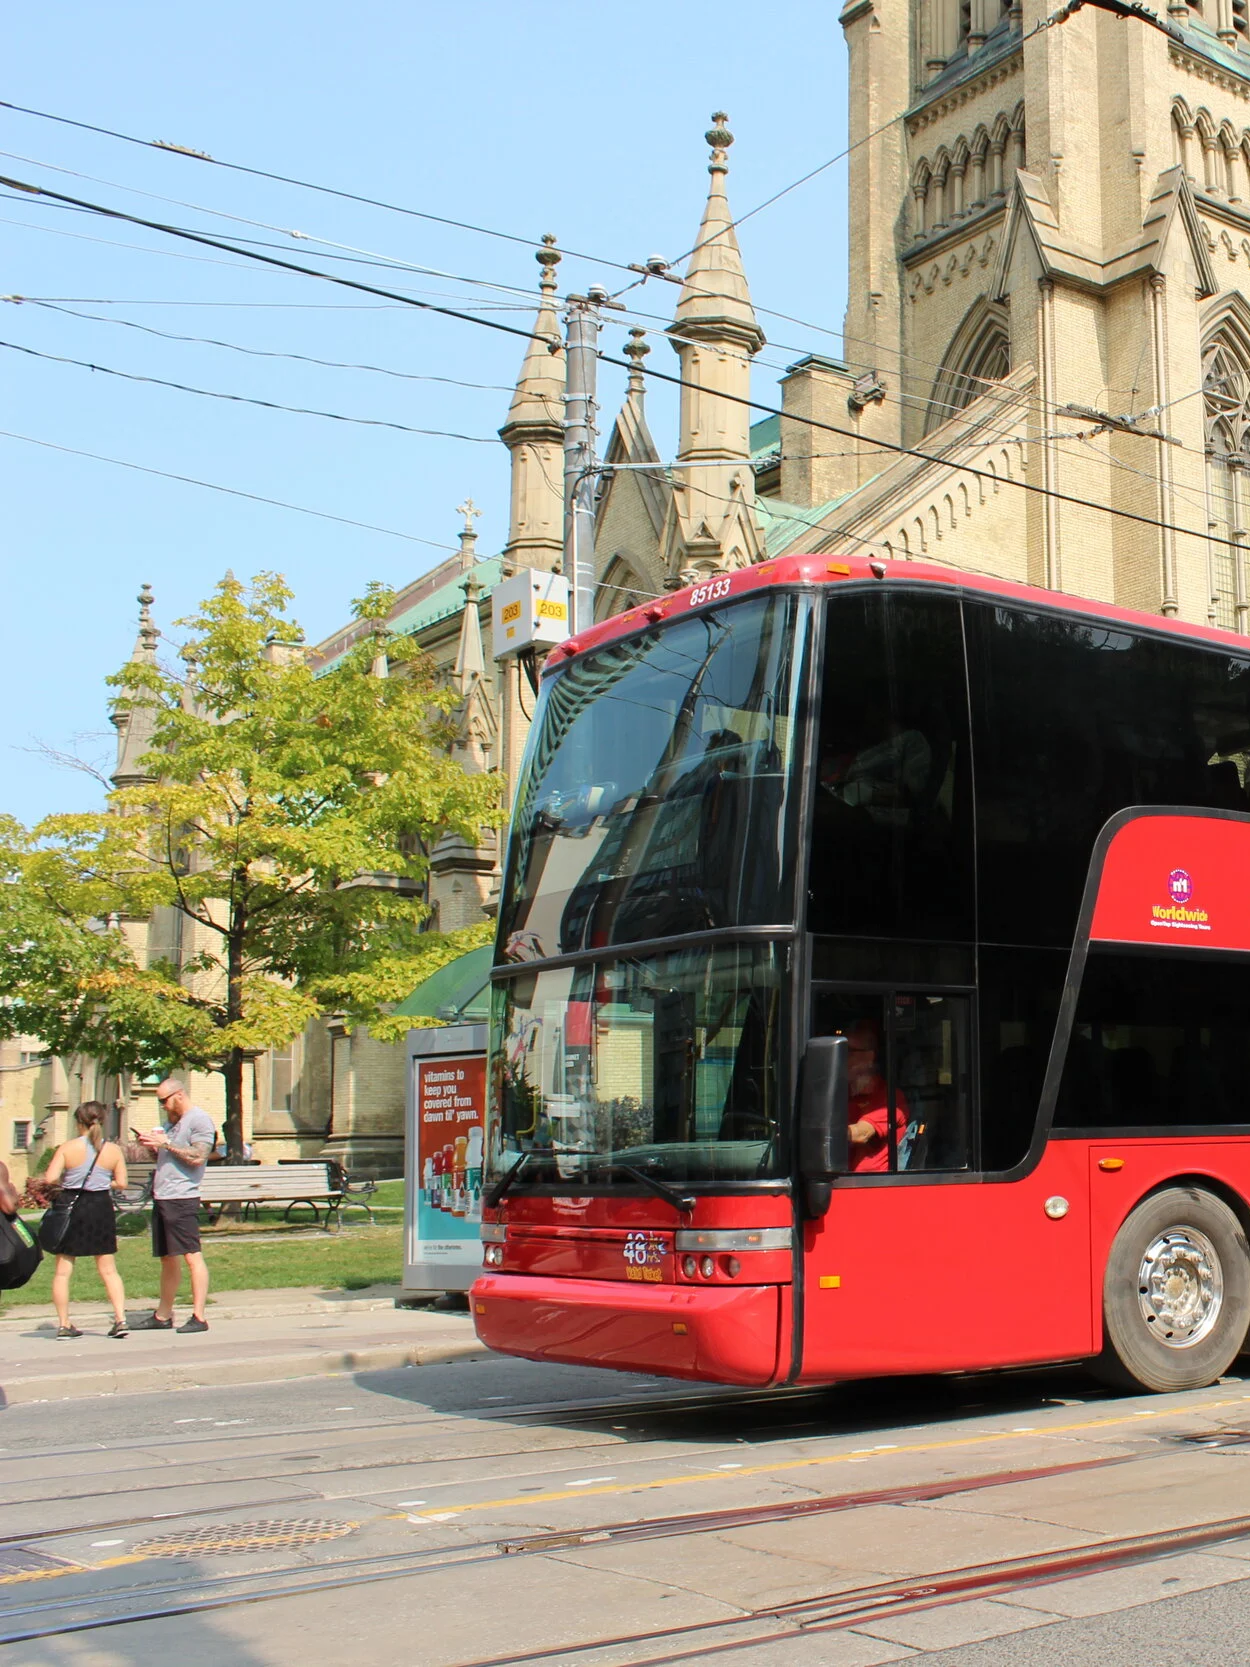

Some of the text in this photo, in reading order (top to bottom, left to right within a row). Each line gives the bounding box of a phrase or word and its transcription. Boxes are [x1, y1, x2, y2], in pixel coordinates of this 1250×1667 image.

[689, 578, 731, 606] 85133
[503, 603, 518, 620] 203
[540, 602, 562, 617] 203
[1152, 905, 1208, 921] Worldwide
[424, 1069, 465, 1083] vitamins to
[424, 1085, 457, 1097] keep you
[424, 1096, 472, 1109] covered from
[424, 1111, 444, 1123] dawn
[456, 1110, 479, 1123] yawn.
[623, 1232, 647, 1264] 48
